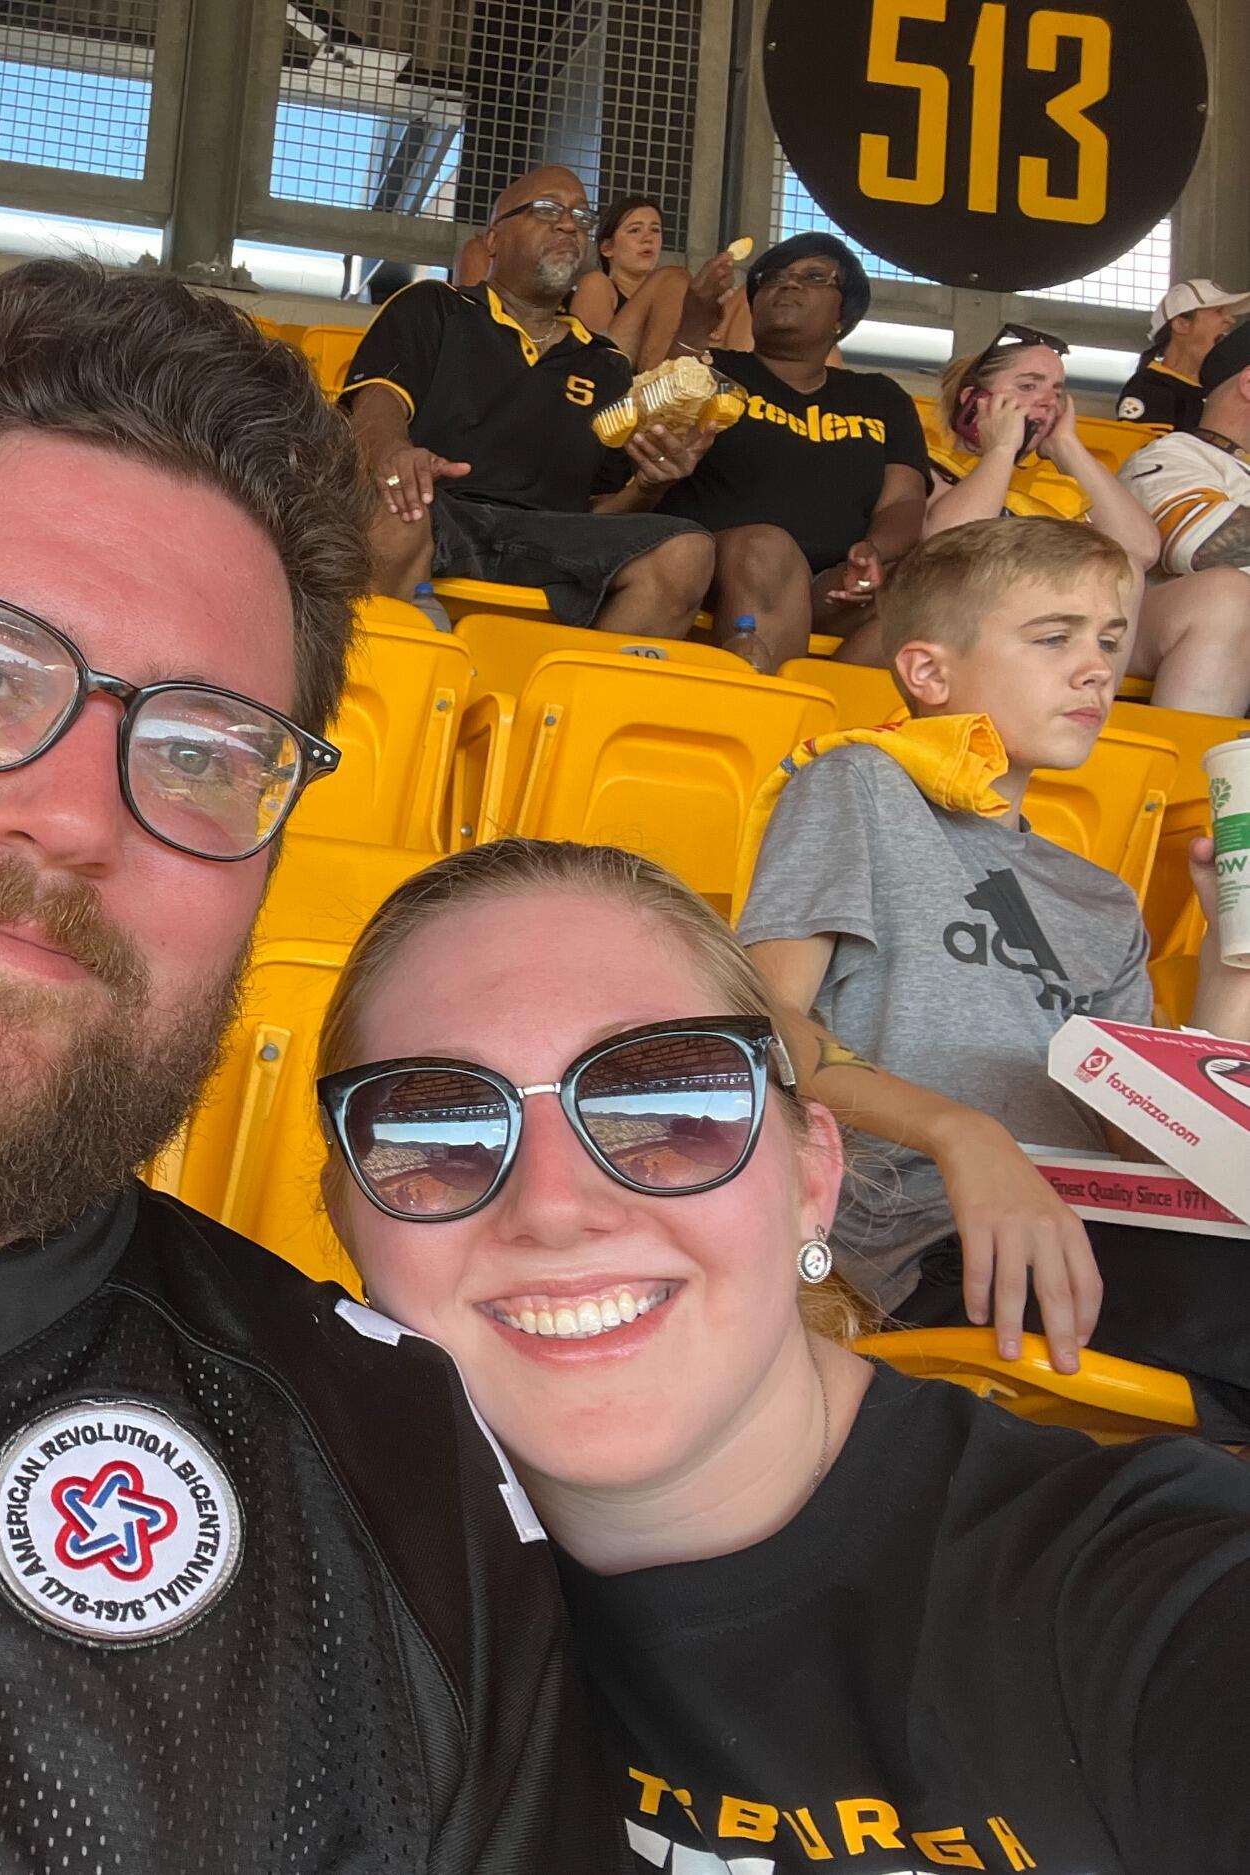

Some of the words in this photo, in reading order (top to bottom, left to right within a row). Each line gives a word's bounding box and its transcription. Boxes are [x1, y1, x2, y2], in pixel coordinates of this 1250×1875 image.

[858, 0, 1111, 225] 513
[565, 374, 596, 406] S
[747, 395, 886, 444] teelers
[1106, 1071, 1201, 1147] foxspizza.com
[1088, 1180, 1135, 1207] Quality
[1137, 1185, 1173, 1207] Since
[39, 1421, 180, 1466] REVOLUTION
[6, 1456, 47, 1577] AMERICAN
[145, 1459, 221, 1612] BICENTENNIAL
[38, 1575, 147, 1622] 1776-1976
[628, 1766, 1037, 1872] TBURGH
